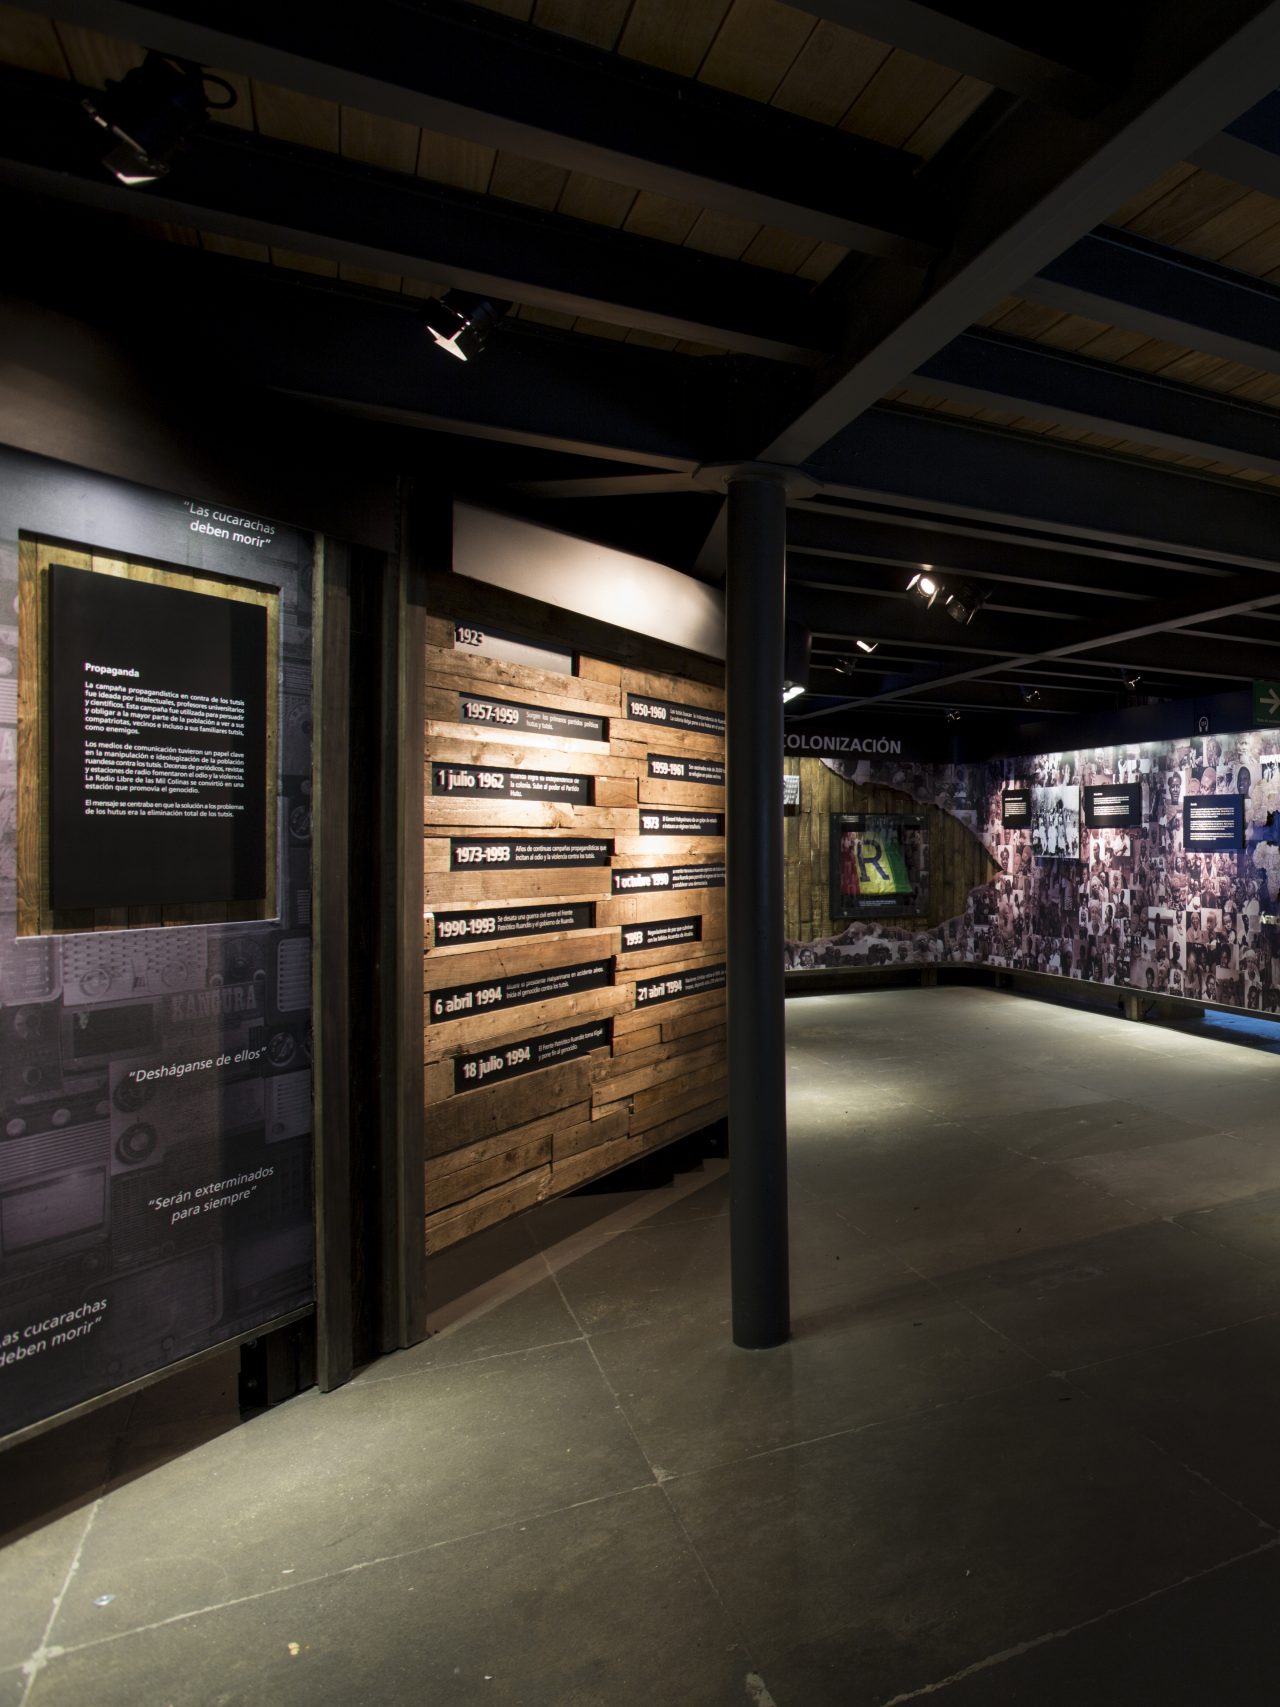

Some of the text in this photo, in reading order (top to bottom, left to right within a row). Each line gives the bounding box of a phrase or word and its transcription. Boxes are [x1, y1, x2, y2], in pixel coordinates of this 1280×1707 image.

[190, 520, 229, 539] deben
[213, 508, 275, 535] cucarachas
[85, 663, 139, 678] Propaganda
[85, 690, 97, 698] fue
[98, 691, 121, 700] ideada
[135, 695, 175, 706] intelectuales,
[208, 703, 244, 713] universitarios
[95, 684, 126, 692] campaña
[190, 694, 209, 702] contra
[220, 696, 228, 704] los
[230, 697, 244, 706] tutsis
[90, 708, 115, 717] obligar
[186, 717, 215, 725] población
[126, 702, 139, 710] Esta
[169, 706, 179, 714] fue
[180, 708, 205, 717] utilizada
[466, 703, 519, 724] 1957-1959
[85, 717, 131, 726] compatriotas,
[132, 720, 156, 728] vecinos
[162, 721, 183, 730] incluso
[200, 725, 227, 734] familiares
[106, 727, 140, 735] enemigos.
[85, 740, 97, 748] Los
[98, 742, 123, 750] medios
[134, 745, 177, 753] comunicación
[178, 746, 203, 755] tuvieron
[213, 749, 229, 758] papel
[104, 751, 148, 759] manipulación
[156, 753, 200, 762] ideologización
[217, 757, 244, 765] población
[116, 759, 136, 767] contra
[146, 760, 163, 768] tutsis.
[164, 761, 187, 769] Decenas
[85, 782, 113, 790] estación
[169, 786, 200, 794] genocidio.
[95, 774, 115, 782] Radio
[117, 775, 133, 783] Libre
[145, 776, 154, 784] las
[167, 777, 189, 785] Colinas
[198, 779, 223, 787] convirtió
[438, 770, 445, 785] 1
[449, 770, 475, 789] julio
[478, 772, 504, 788] 1962
[456, 846, 510, 863] 1973-1993
[857, 840, 890, 882] R
[438, 918, 495, 938] 1990-1993
[638, 988, 647, 1001] 21
[649, 984, 665, 998] abril
[667, 980, 682, 994] 1994
[434, 987, 502, 1015] 6 abril 1994
[216, 1054, 231, 1066] de
[463, 1046, 531, 1079] 18 julio 1994
[194, 1166, 275, 1199] exterminados
[171, 1204, 200, 1225] para
[24, 1298, 107, 1339] cucarachas
